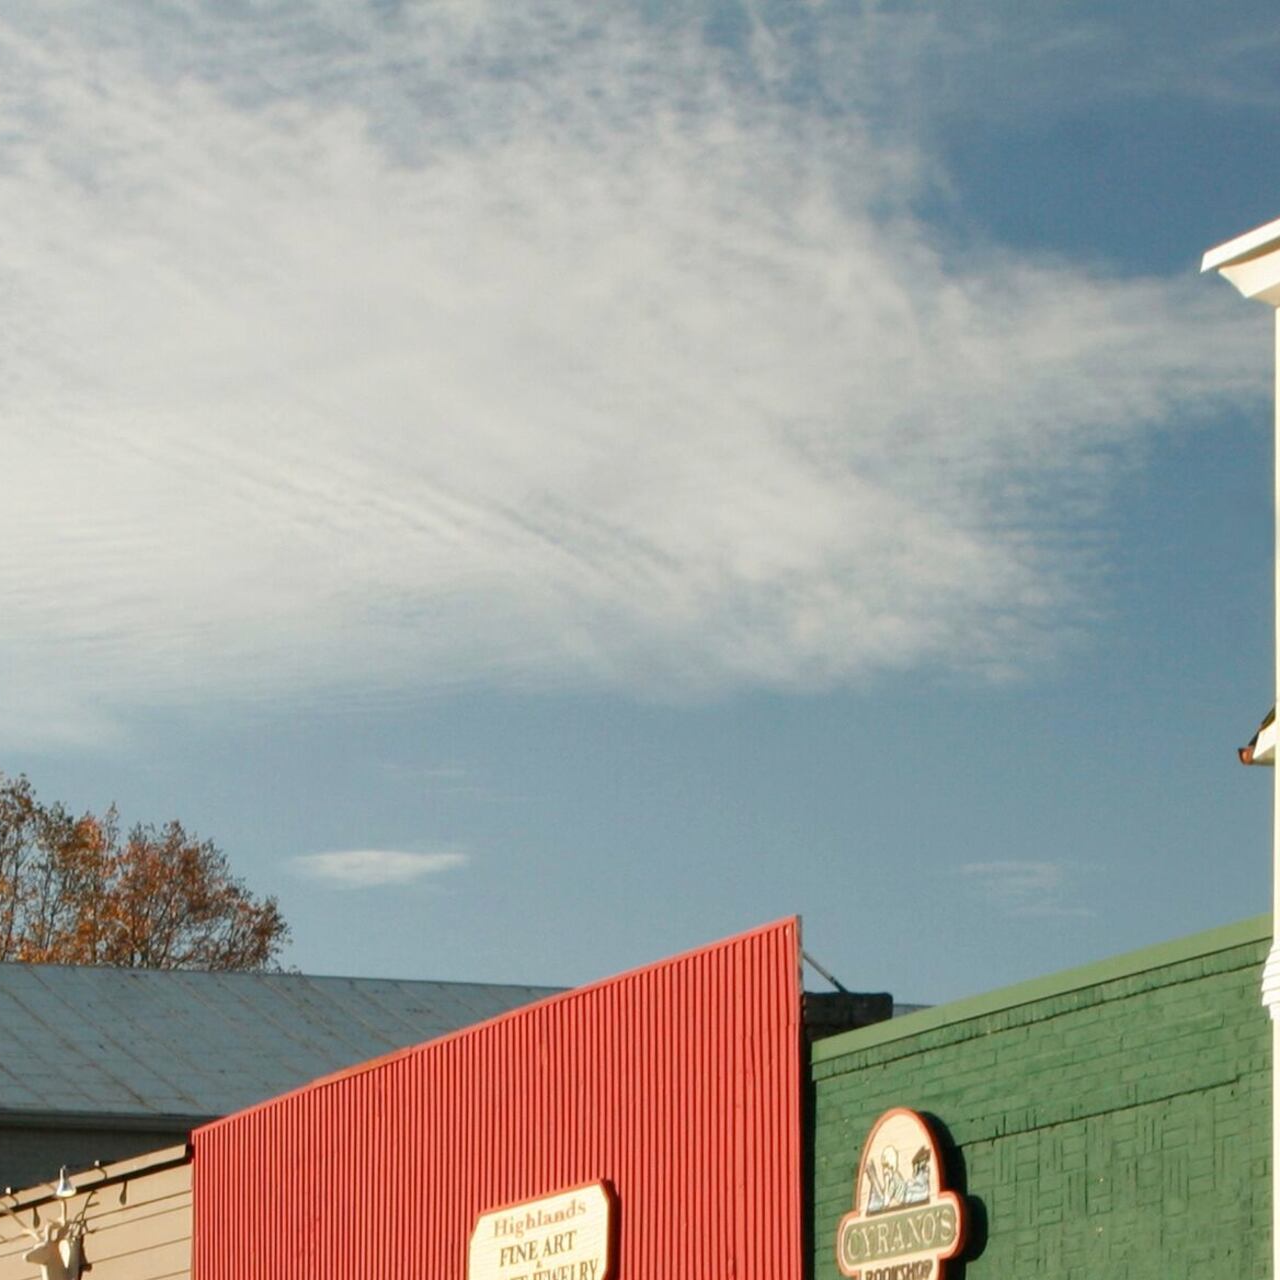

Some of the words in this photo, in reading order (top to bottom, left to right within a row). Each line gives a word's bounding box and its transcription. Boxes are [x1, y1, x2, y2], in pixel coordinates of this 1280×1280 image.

[493, 1198, 587, 1239] Highlands
[847, 1209, 952, 1260] CYRANO'S
[499, 1239, 539, 1268] FINE
[542, 1229, 578, 1258] ART
